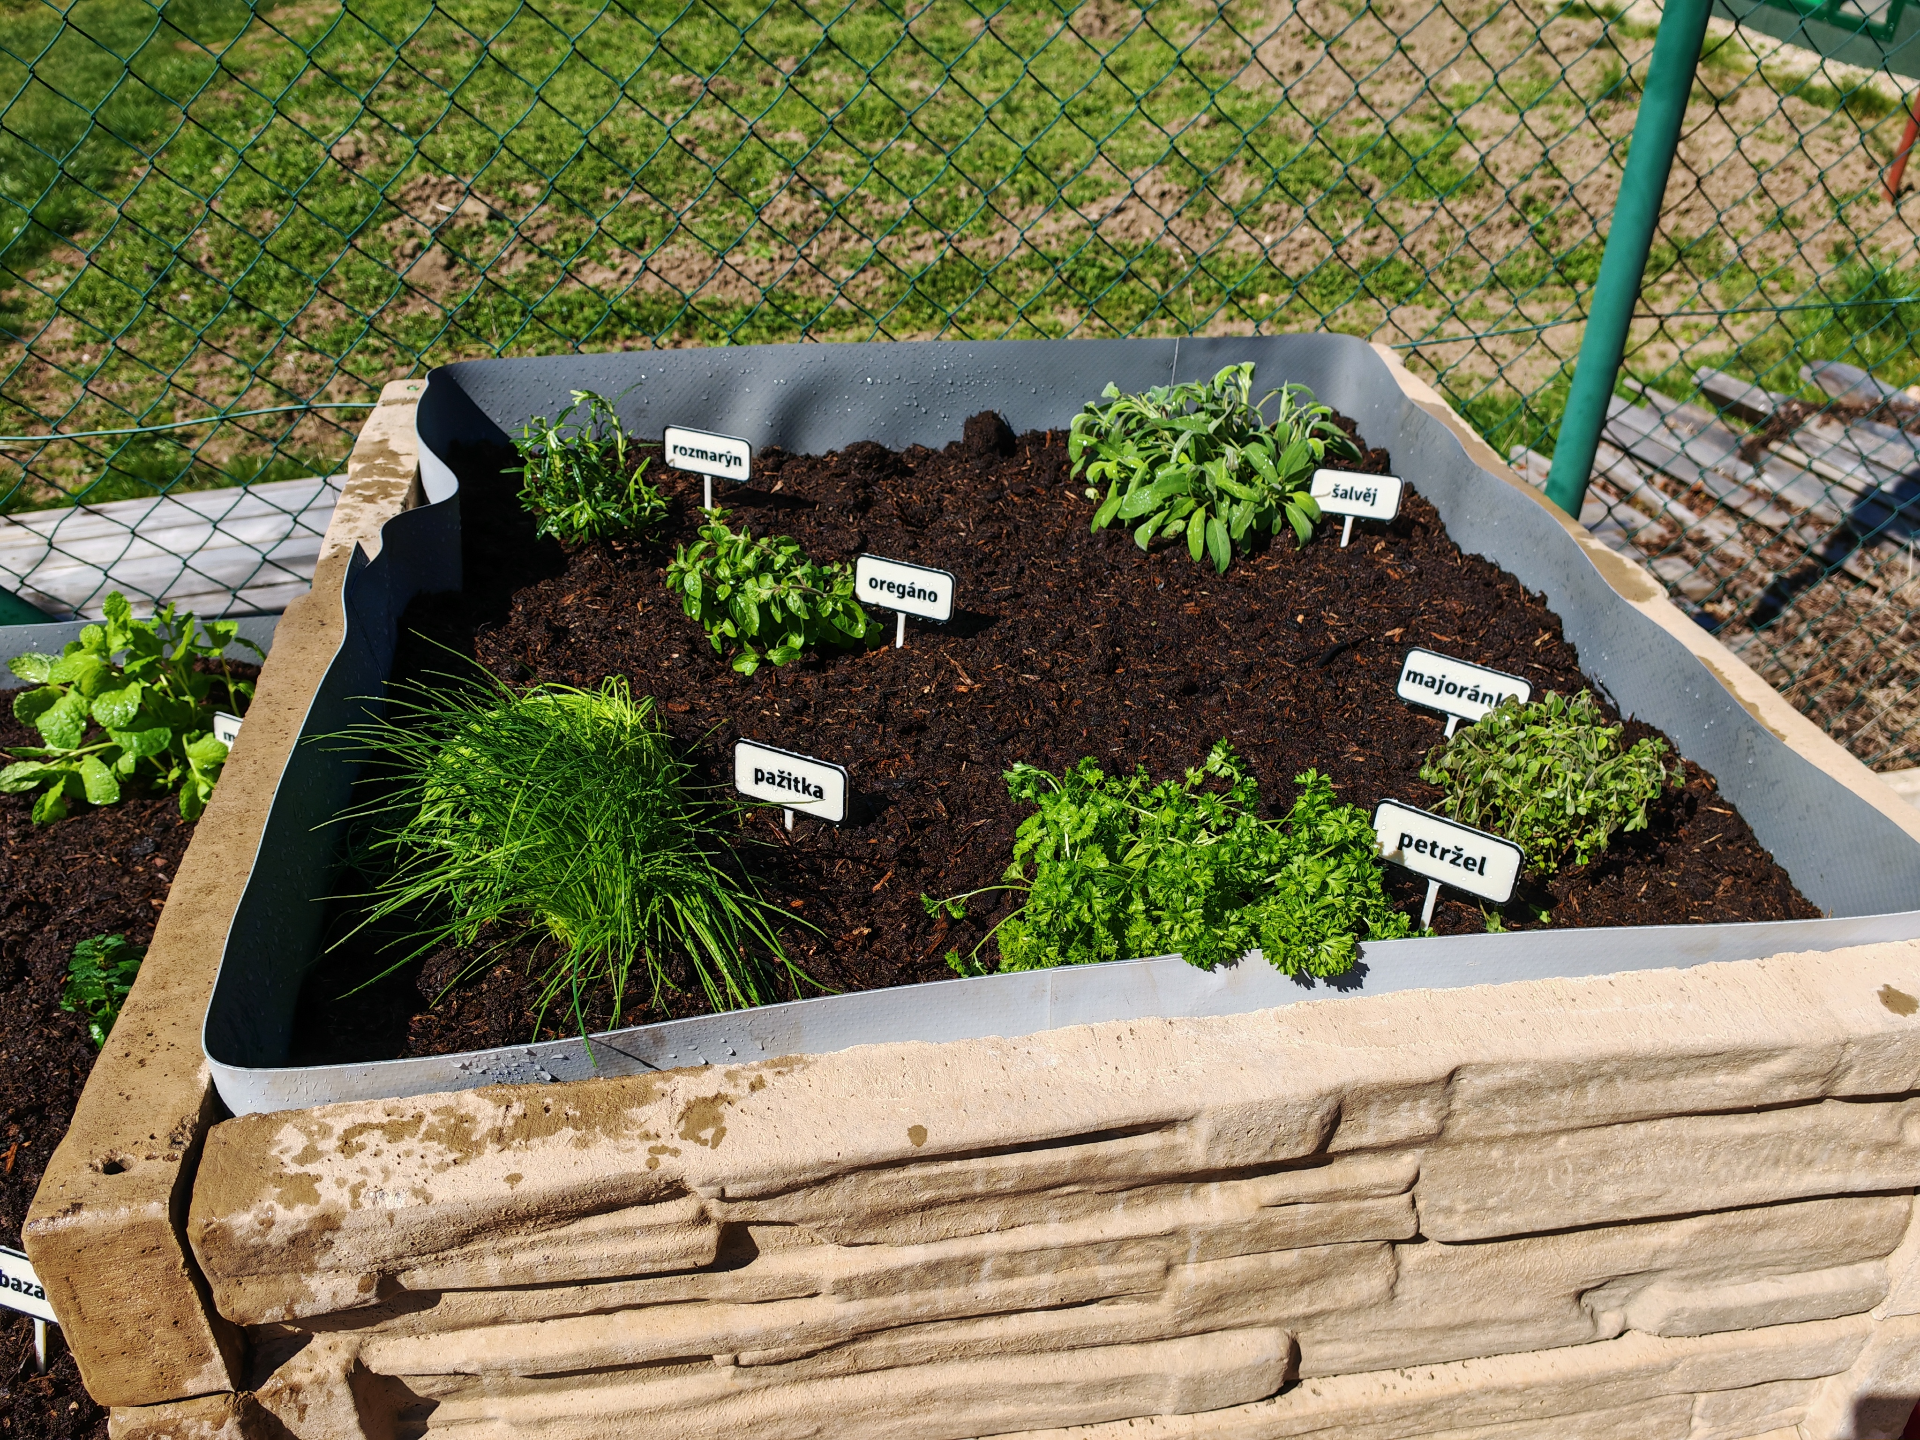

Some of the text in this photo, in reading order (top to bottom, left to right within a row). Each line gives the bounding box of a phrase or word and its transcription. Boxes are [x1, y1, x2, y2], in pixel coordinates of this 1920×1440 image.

[1331, 483, 1378, 507] šalvěj
[868, 577, 938, 603] oregáno
[754, 767, 824, 800] pažitka
[1398, 832, 1487, 876] petržel
